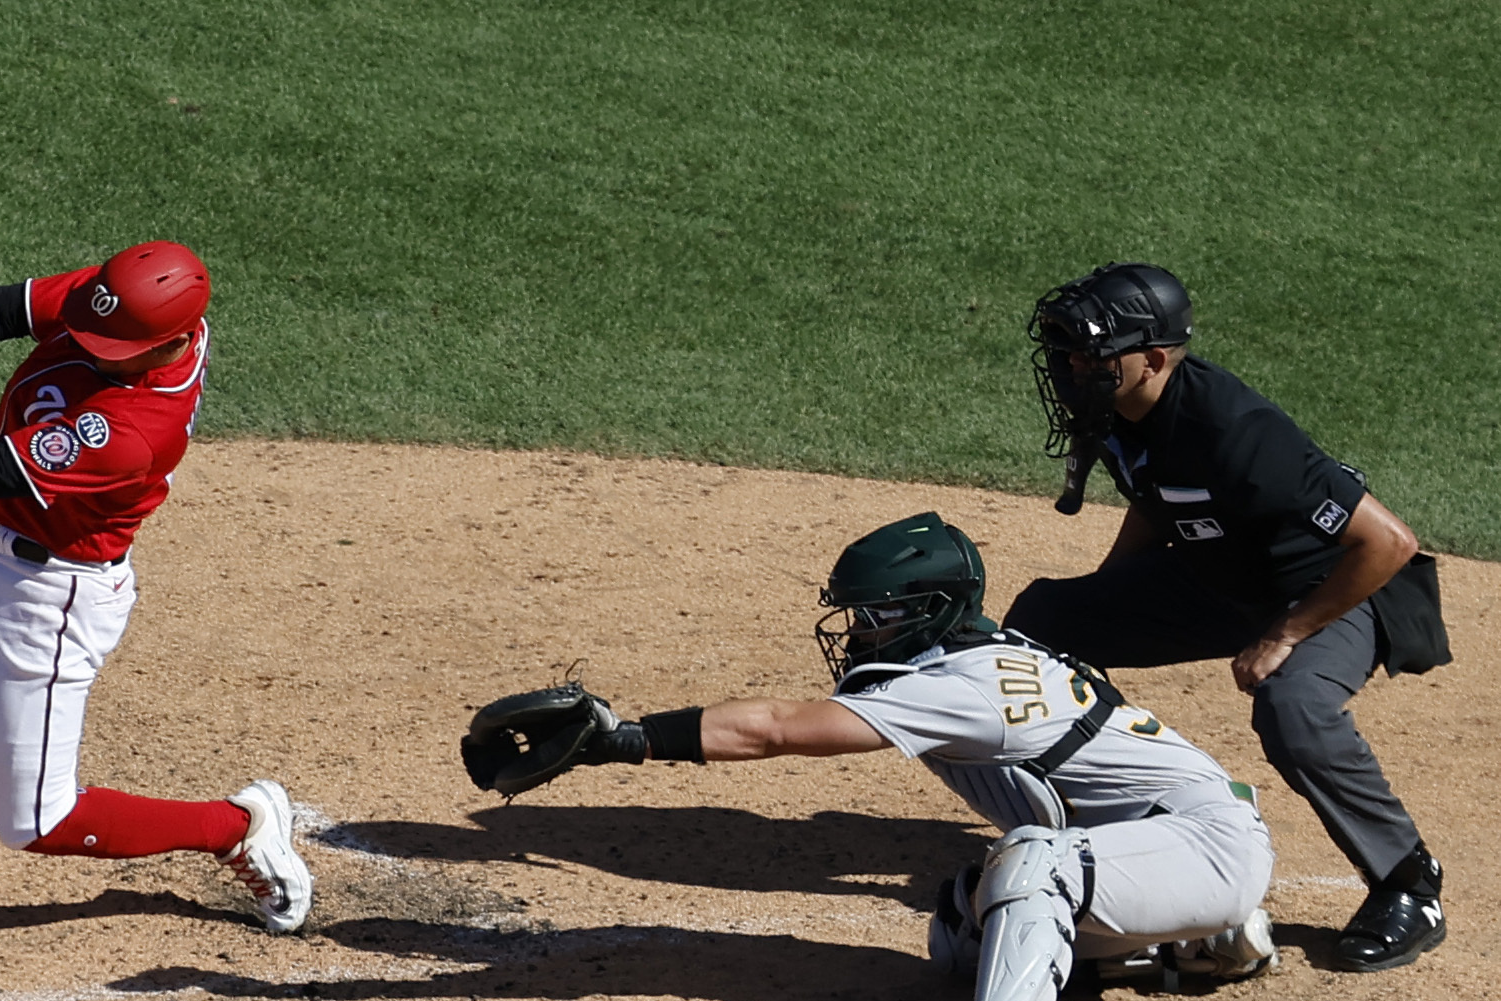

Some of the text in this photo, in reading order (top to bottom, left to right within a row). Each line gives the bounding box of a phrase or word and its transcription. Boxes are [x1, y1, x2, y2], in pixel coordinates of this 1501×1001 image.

[91, 283, 118, 318] W
[79, 413, 103, 446] TNL
[30, 430, 53, 470] NATIONALS
[1319, 505, 1342, 528] DM
[1421, 899, 1443, 928] N
